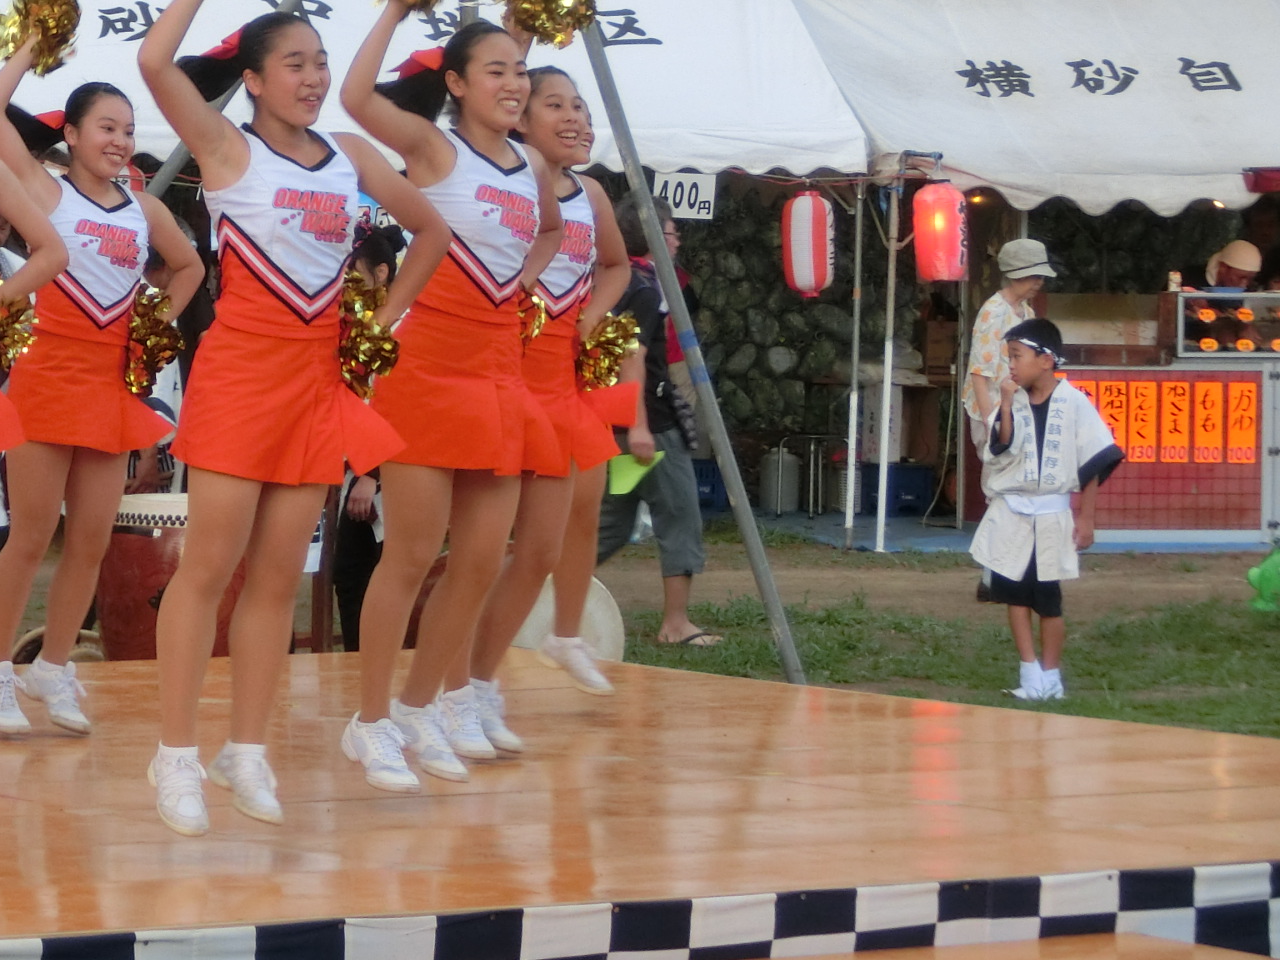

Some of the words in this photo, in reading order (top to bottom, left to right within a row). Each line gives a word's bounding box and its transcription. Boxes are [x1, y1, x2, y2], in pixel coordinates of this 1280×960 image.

[272, 187, 348, 215] ORANGE
[475, 183, 536, 217] ORANGE
[658, 179, 712, 215] 400円
[74, 218, 139, 247] ORANGE
[299, 210, 352, 235] WAVE
[499, 206, 538, 235] WAVE
[96, 238, 142, 261] WAVE
[1133, 385, 1153, 440] にんにく
[1200, 390, 1216, 433] もも
[1231, 389, 1254, 432] かわ
[1130, 445, 1155, 460] 130
[1161, 445, 1186, 460] 100
[1195, 446, 1220, 461] 100
[1228, 446, 1253, 461] 100
